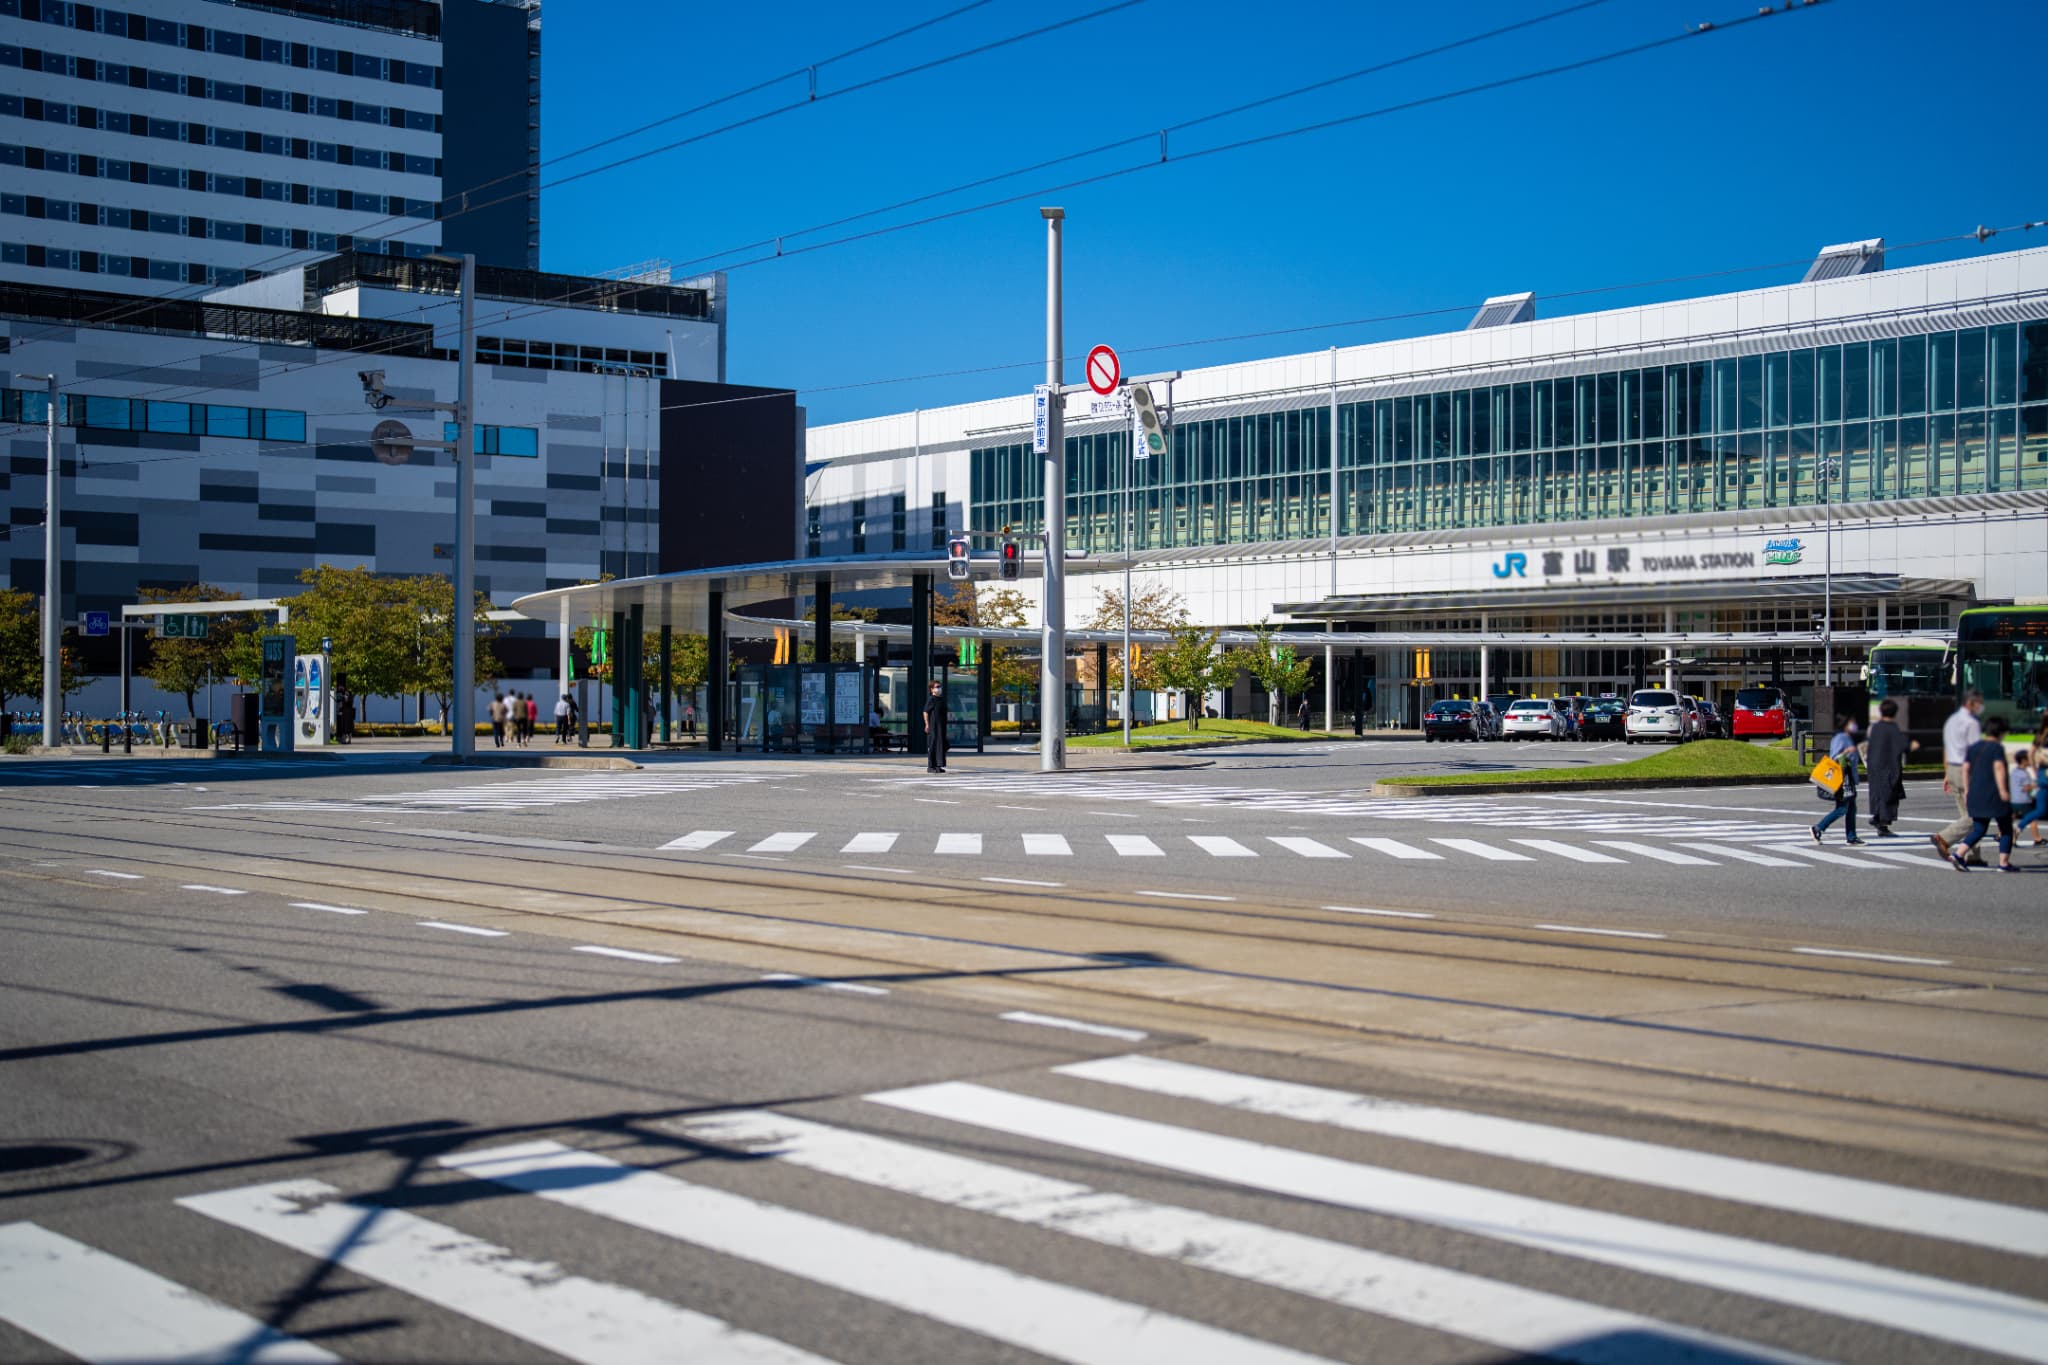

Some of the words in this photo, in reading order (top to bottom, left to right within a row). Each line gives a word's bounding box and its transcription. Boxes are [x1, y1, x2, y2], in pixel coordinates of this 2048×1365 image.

[1492, 552, 1527, 578] JR
[1542, 547, 1630, 576] 富山駅
[1641, 555, 1697, 572] TOYAMA
[1700, 552, 1755, 569] STATION
